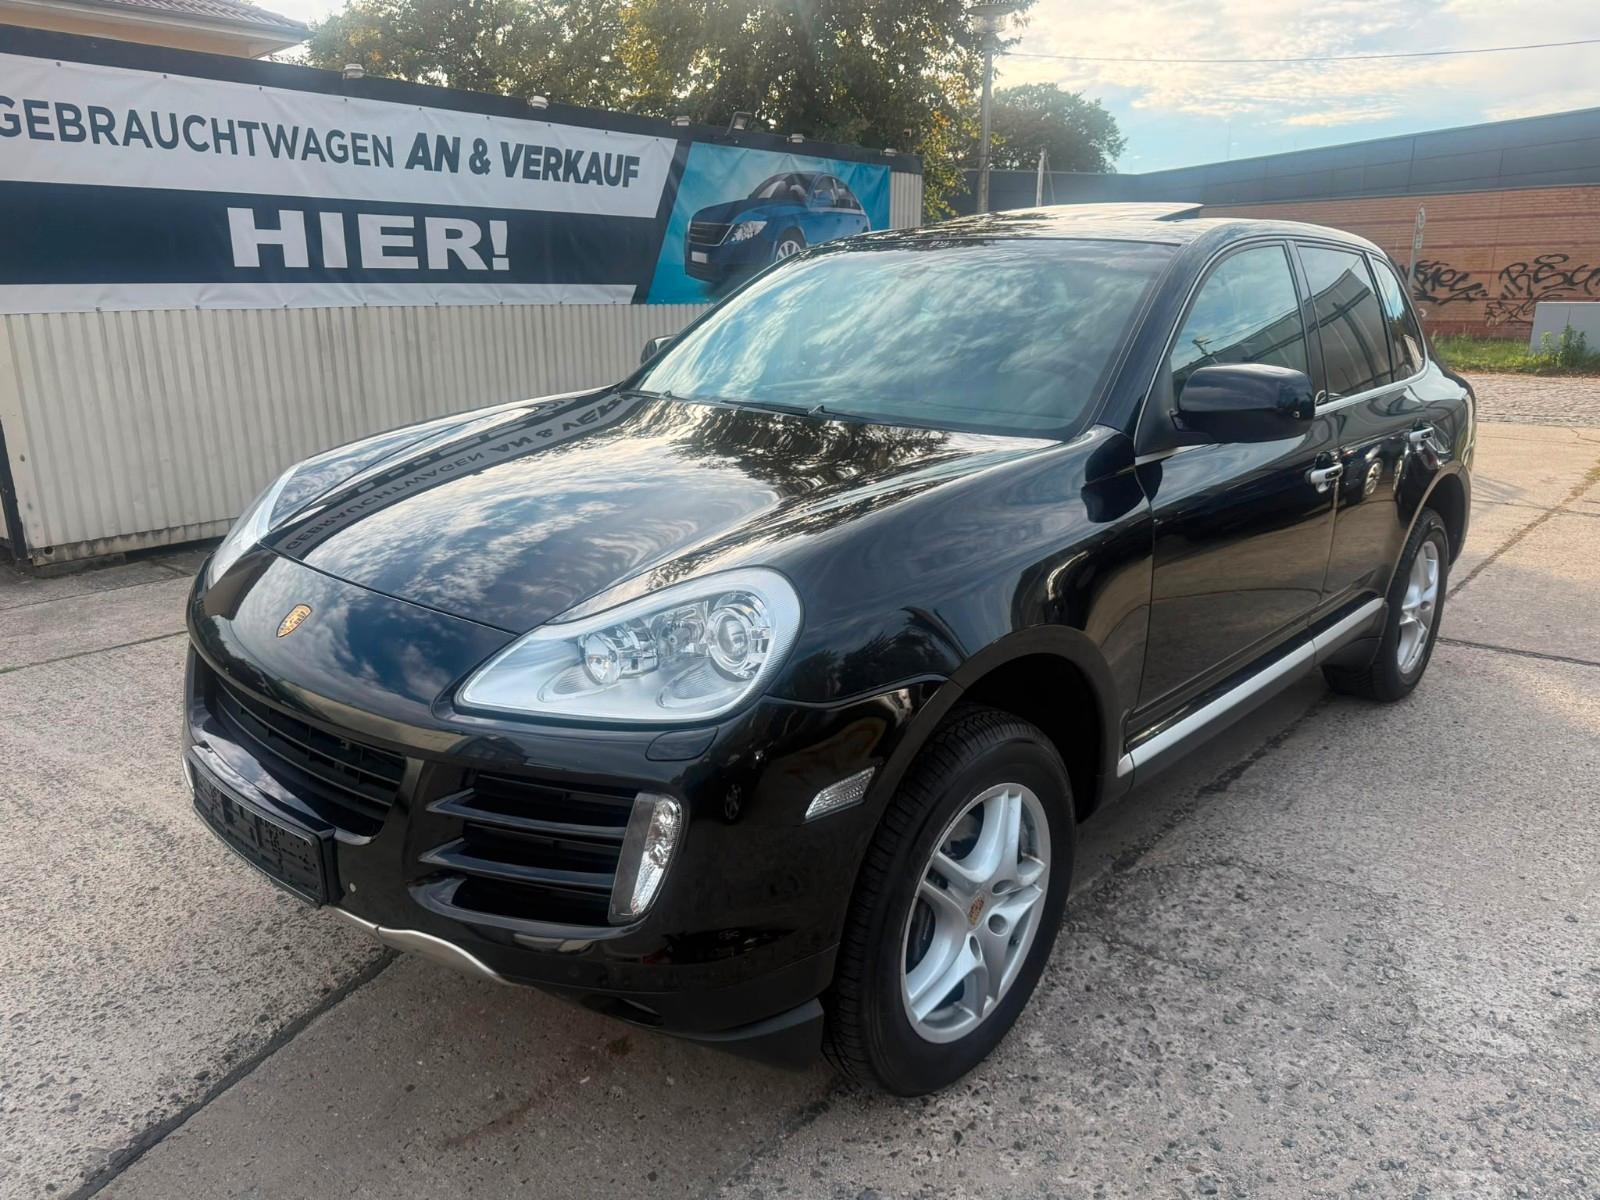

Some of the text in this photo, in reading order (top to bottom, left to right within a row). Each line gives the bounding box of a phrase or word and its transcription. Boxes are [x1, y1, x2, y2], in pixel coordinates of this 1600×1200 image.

[0, 95, 640, 188] GEBRAUCHTWAGEN AN & VERKAUF
[227, 207, 510, 271] HIER!
